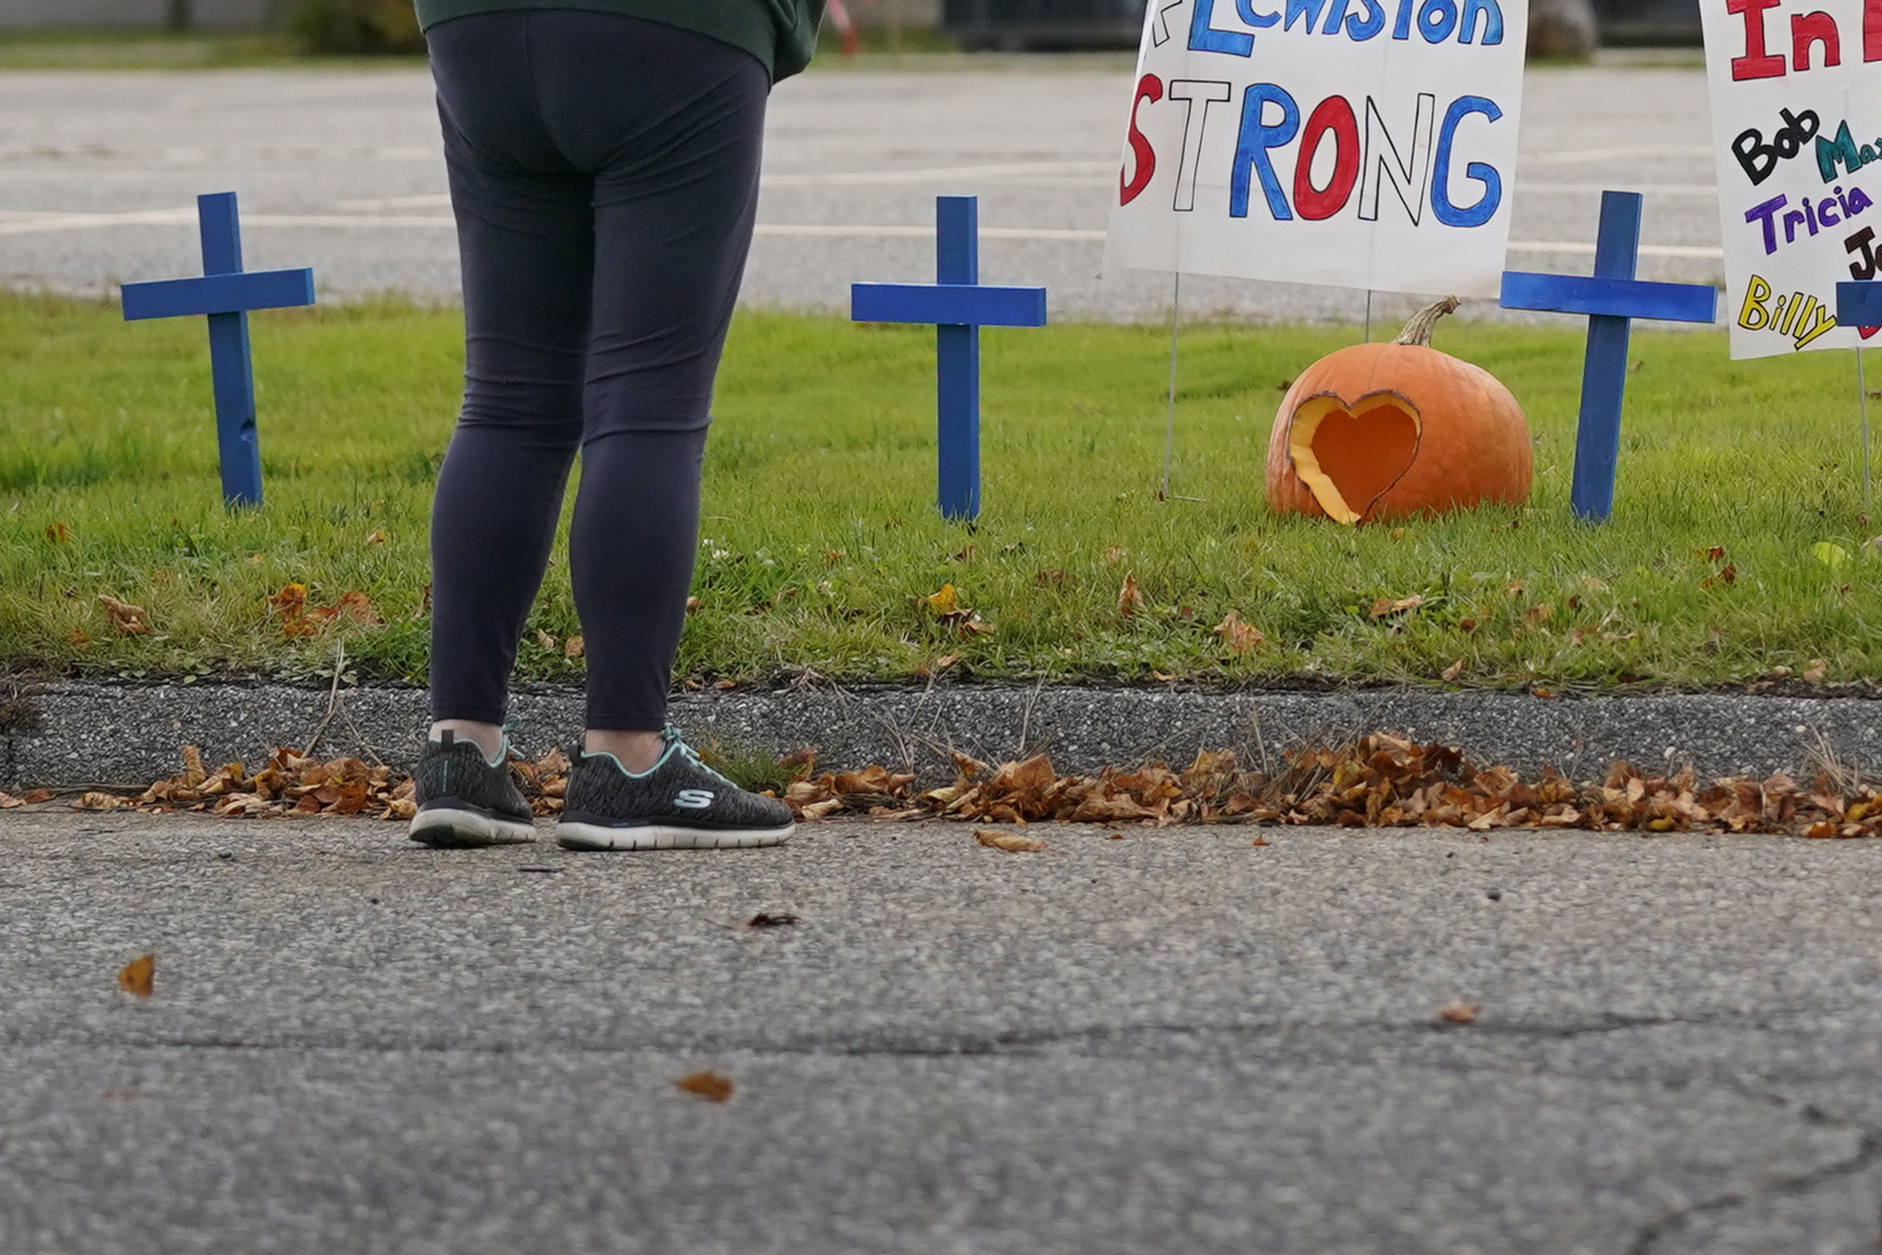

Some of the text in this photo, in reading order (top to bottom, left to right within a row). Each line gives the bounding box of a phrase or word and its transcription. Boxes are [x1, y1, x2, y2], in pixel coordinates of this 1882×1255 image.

[1119, 73, 1504, 228] STRONG
[1731, 107, 1821, 186] Bob
[1745, 185, 1874, 256] Tricia
[1737, 273, 1837, 351] Billy
